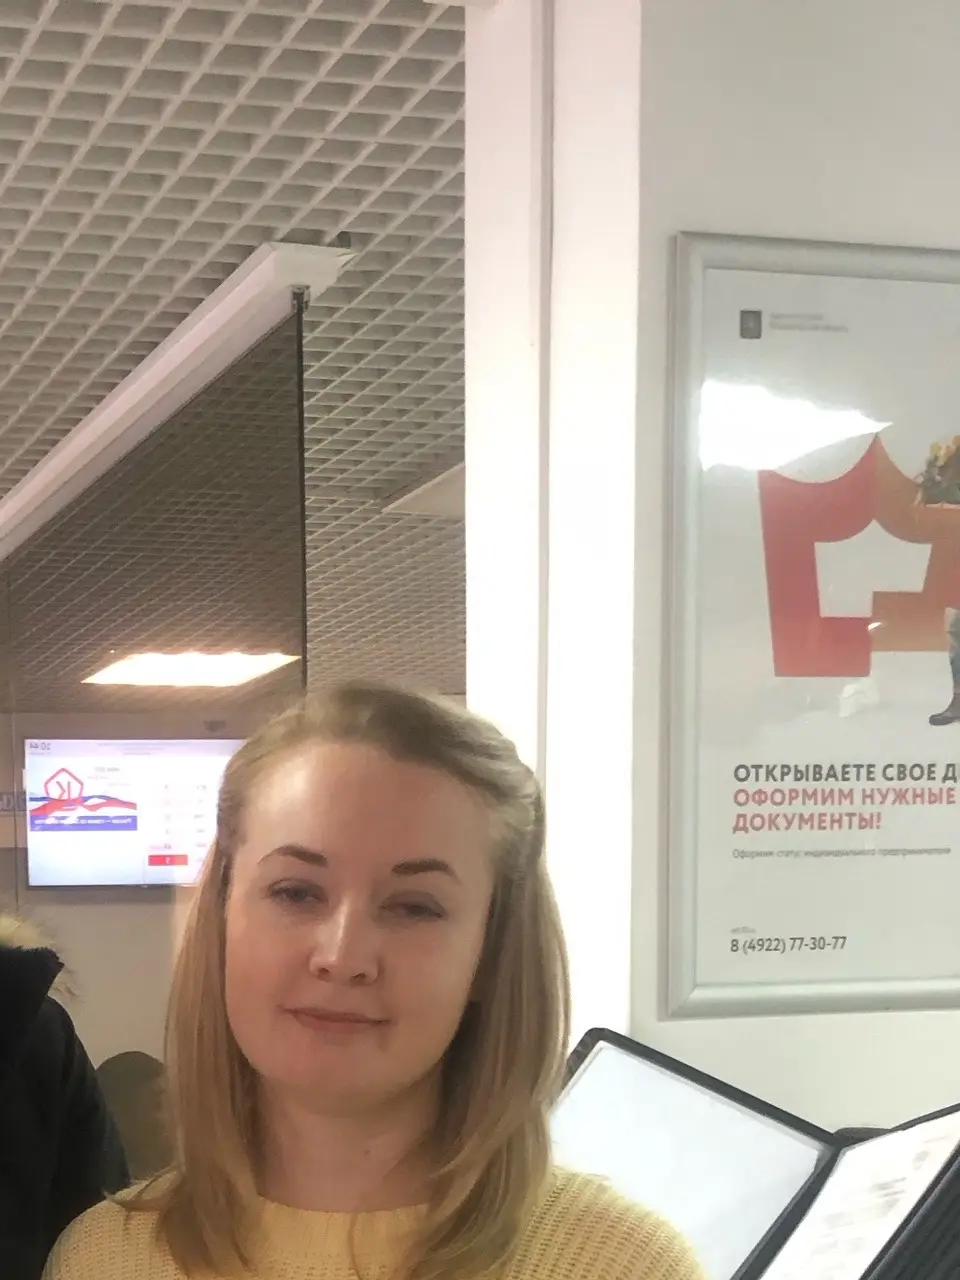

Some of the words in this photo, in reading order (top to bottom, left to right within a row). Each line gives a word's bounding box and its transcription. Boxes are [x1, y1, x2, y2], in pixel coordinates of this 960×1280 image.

[733, 763, 876, 782] ОТКРЫВАЕТЕ
[882, 763, 937, 781] СВОЕ
[941, 763, 960, 783] Д
[733, 787, 854, 806] ОФОРМИМ
[861, 787, 957, 805] НУЖНЫЕ
[732, 811, 882, 834] ДОКУМЕНТЫ!
[730, 939, 739, 952] 8
[742, 938, 786, 954] (4922)
[789, 936, 847, 951] 77-30-77
